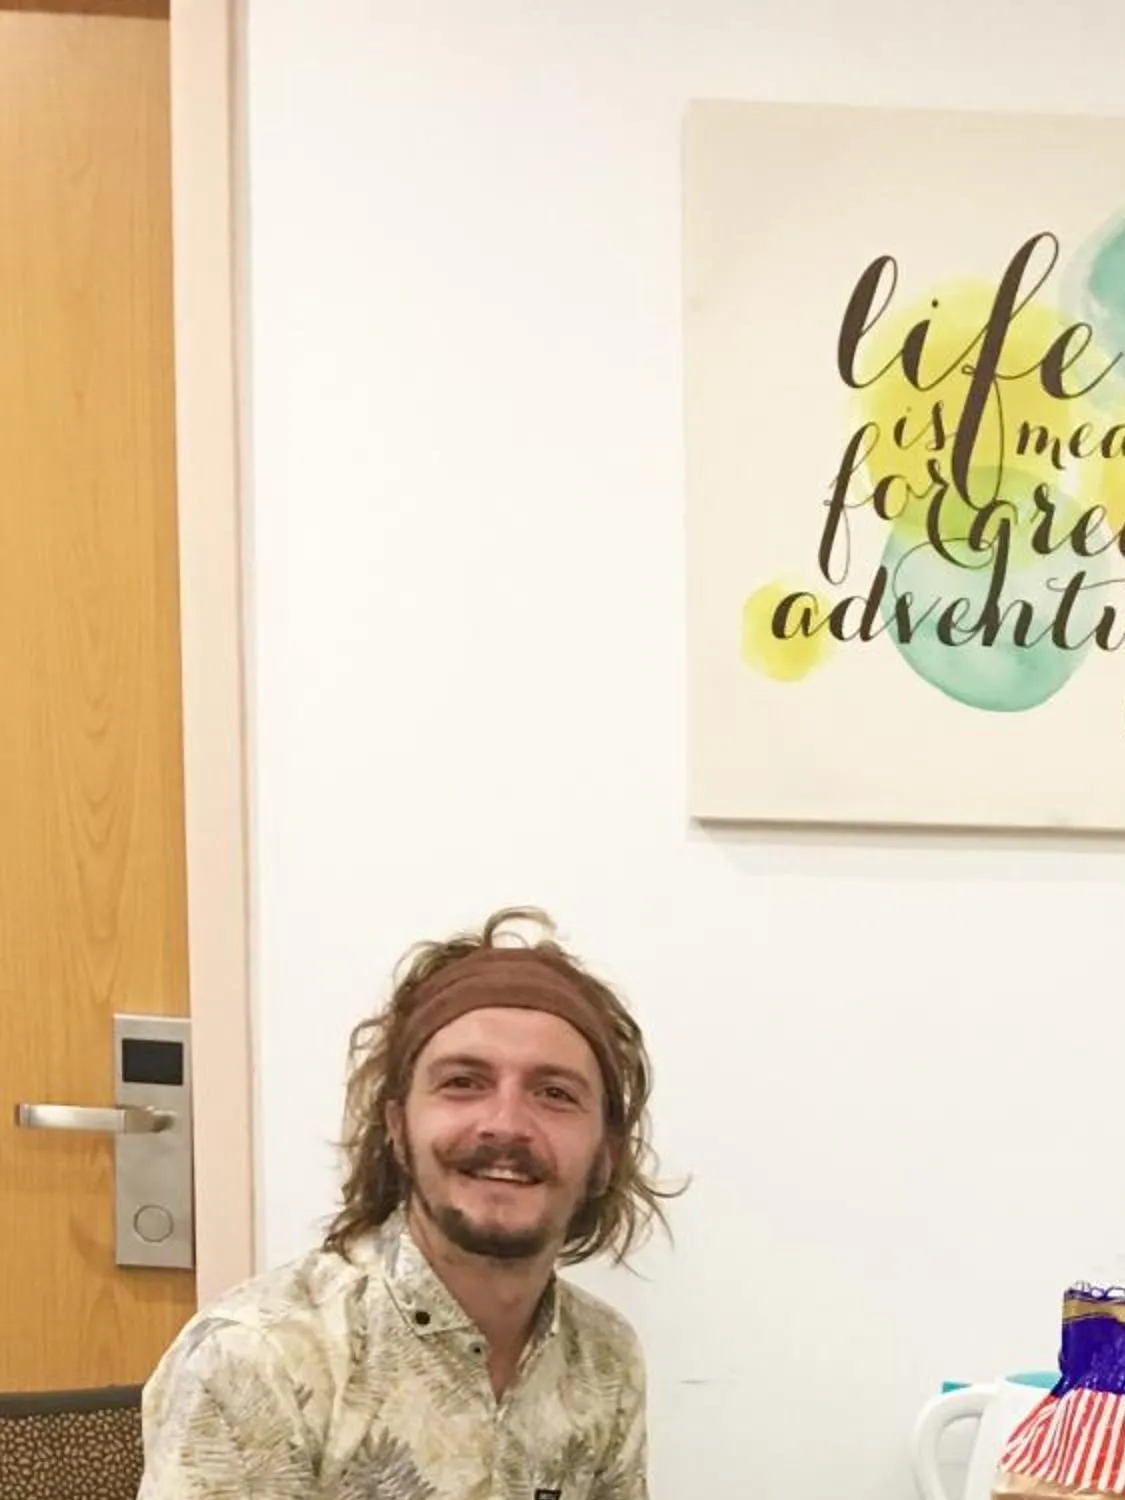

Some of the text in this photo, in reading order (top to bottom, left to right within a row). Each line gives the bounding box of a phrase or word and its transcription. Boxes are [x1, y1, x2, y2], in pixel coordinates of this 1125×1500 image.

[838, 232, 1124, 511] life
[893, 401, 958, 452] is
[818, 422, 996, 597] for
